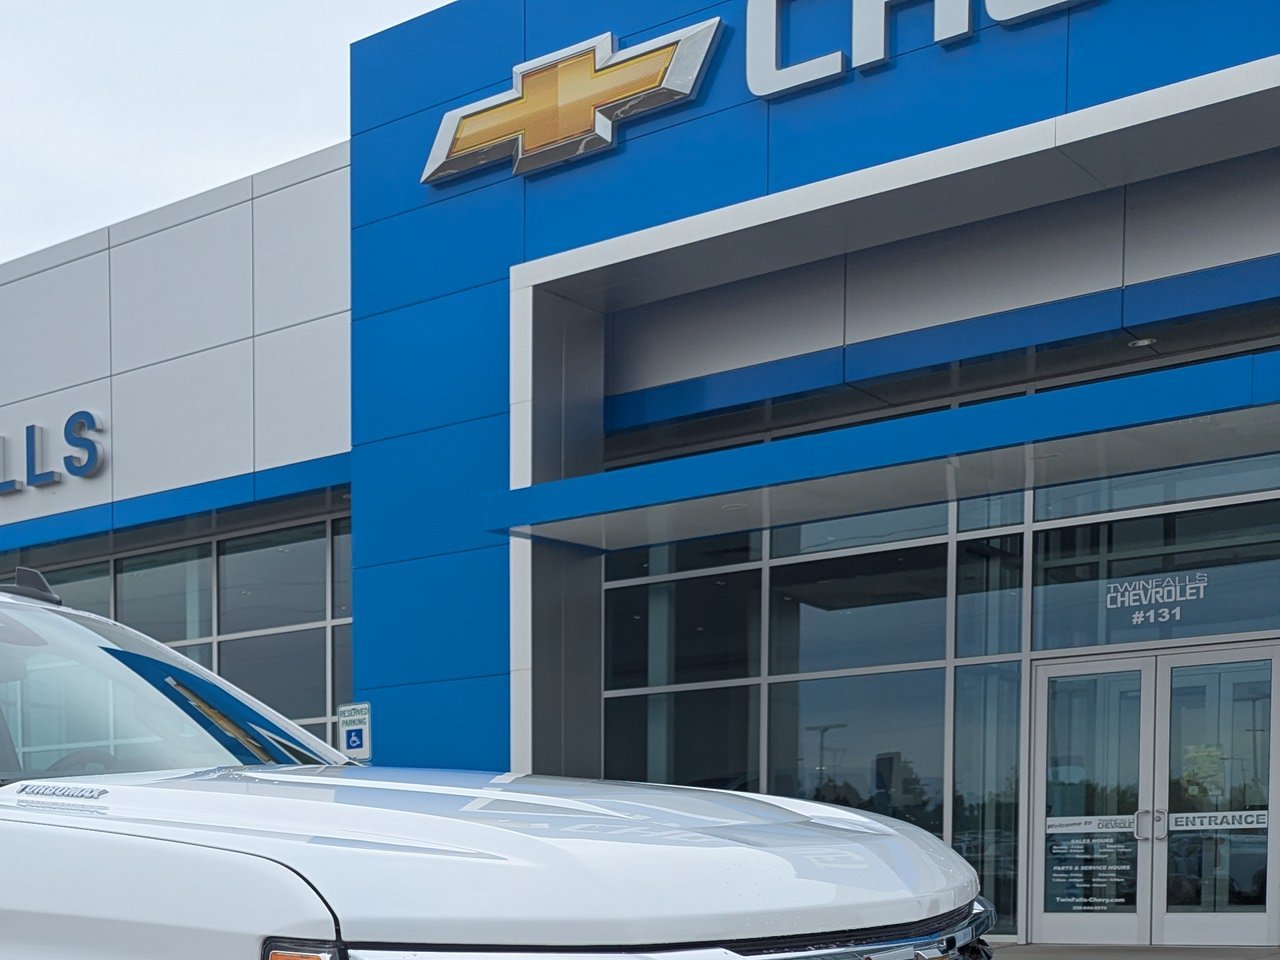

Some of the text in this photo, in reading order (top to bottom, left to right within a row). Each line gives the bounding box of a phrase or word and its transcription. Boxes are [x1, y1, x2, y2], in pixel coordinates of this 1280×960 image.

[1107, 573, 1208, 593] TWINFALLS
[1107, 583, 1208, 609] CHEVROLET
[1131, 606, 1181, 625] #131
[340, 708, 369, 717] RESERVED
[341, 718, 367, 727] PARKING
[1174, 814, 1267, 827] ENTRANCE
